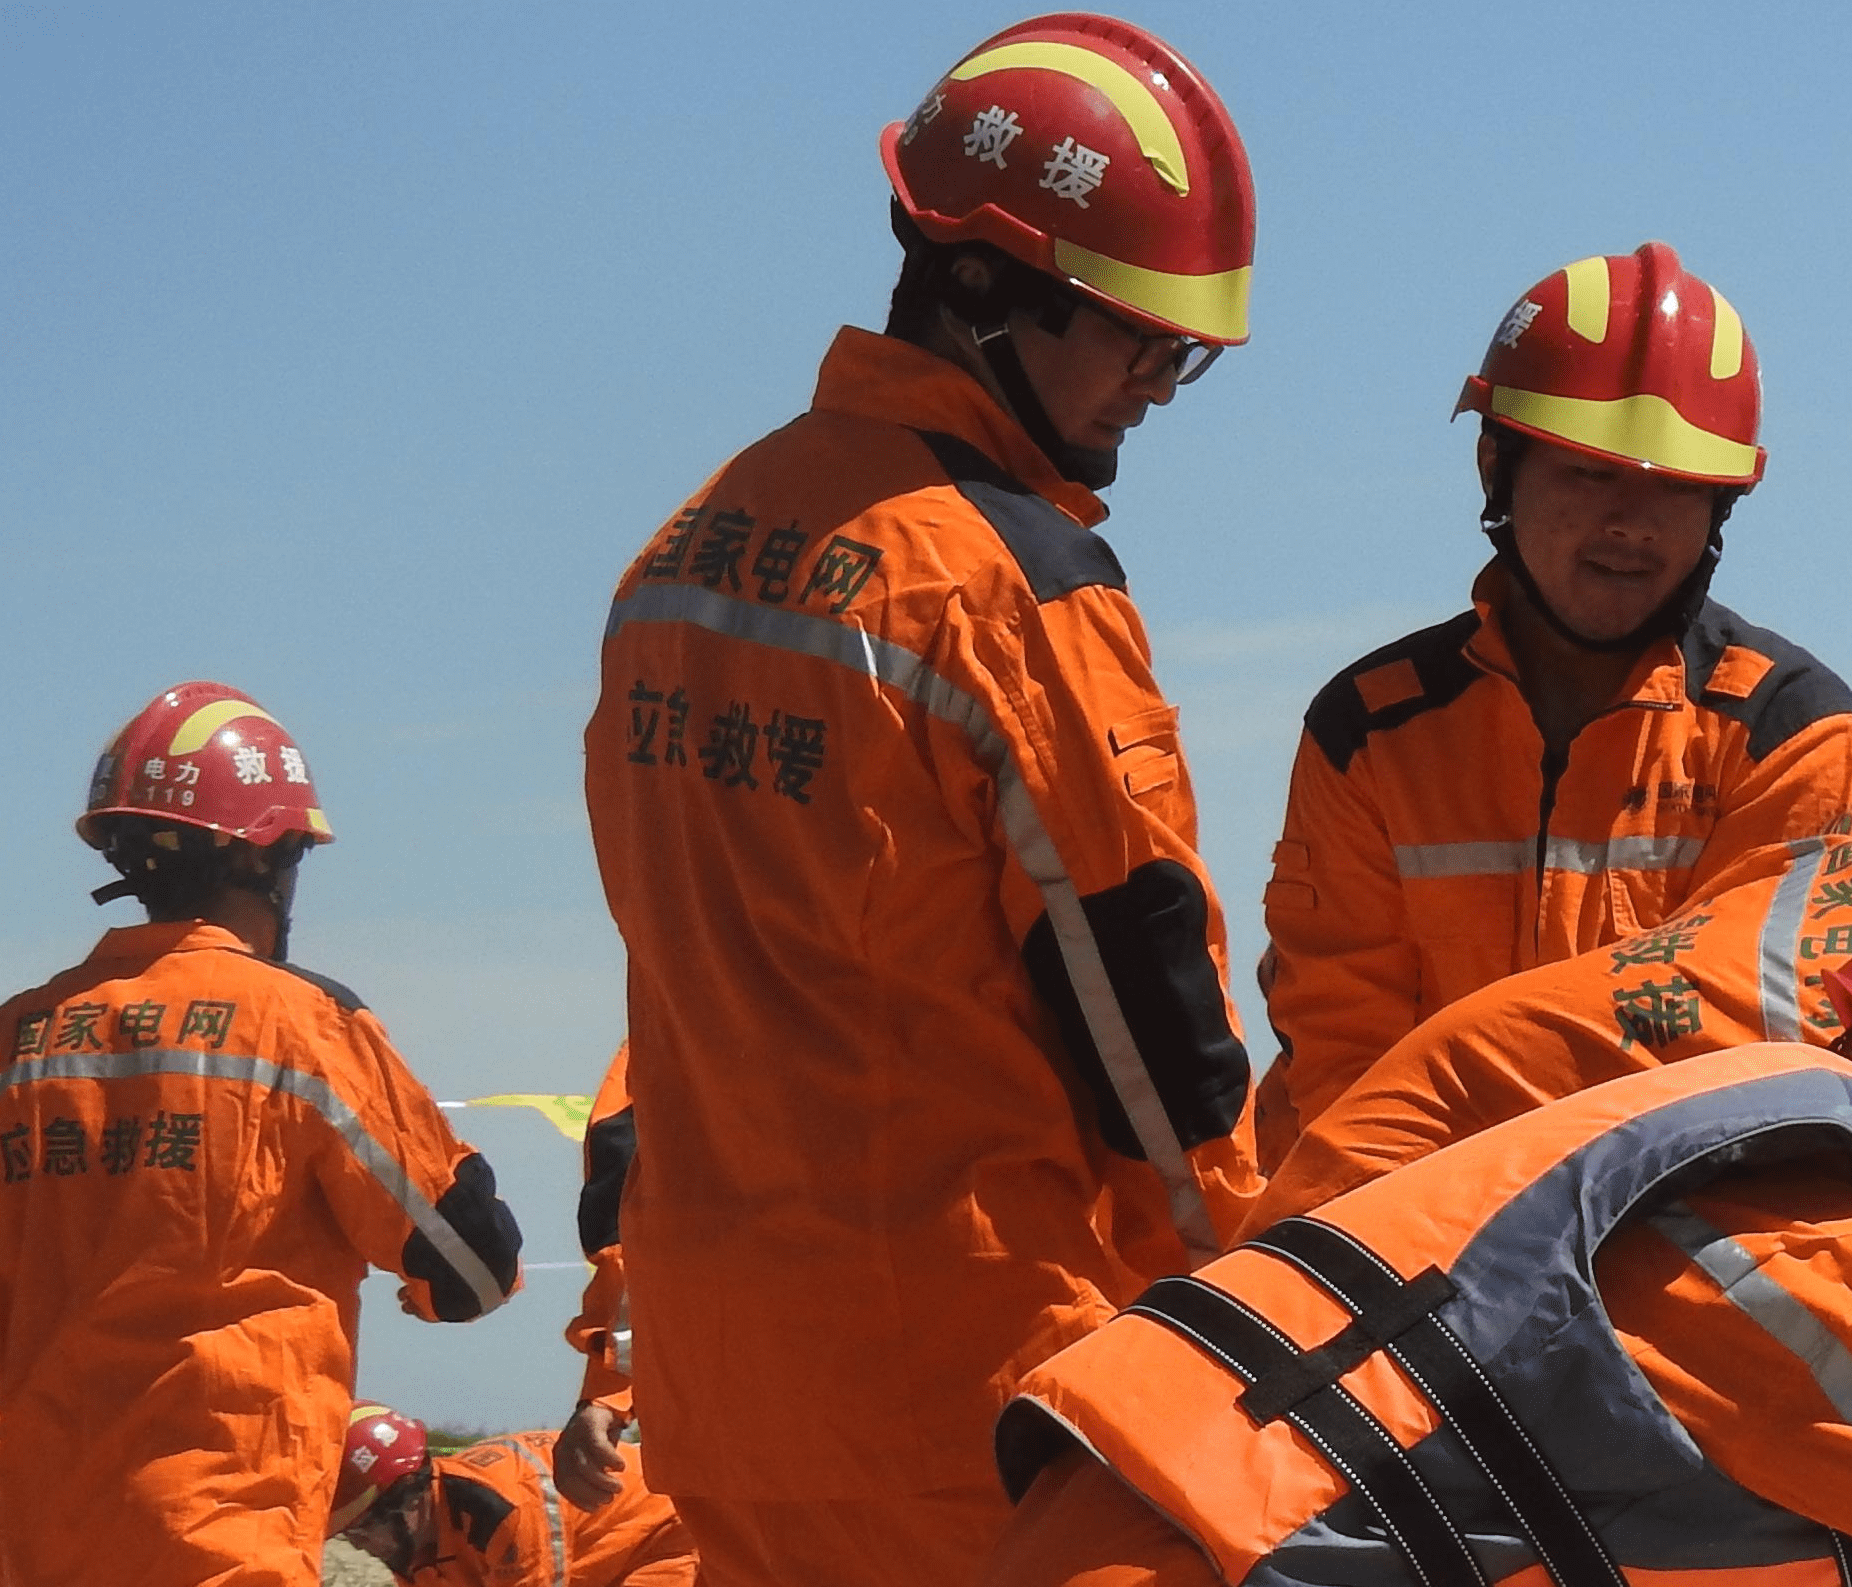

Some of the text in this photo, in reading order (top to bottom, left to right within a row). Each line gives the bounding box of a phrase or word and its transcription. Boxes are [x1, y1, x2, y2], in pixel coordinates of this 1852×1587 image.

[963, 105, 1110, 209] 救援
[144, 757, 200, 785] 电力
[147, 785, 195, 806] 119
[10, 999, 237, 1059] 国家电网
